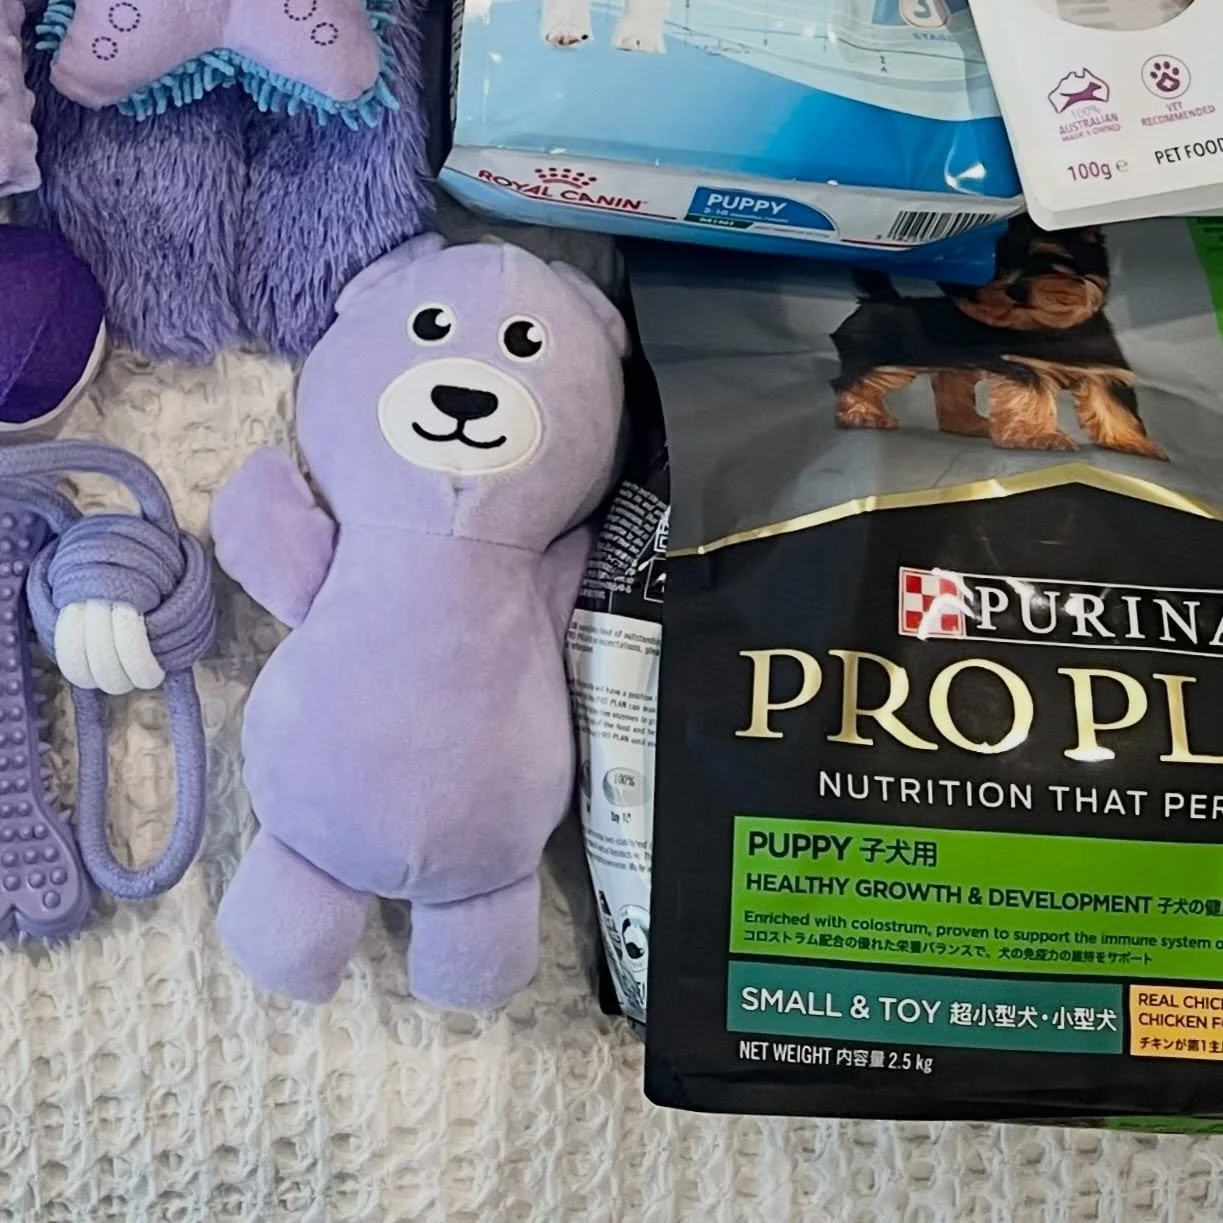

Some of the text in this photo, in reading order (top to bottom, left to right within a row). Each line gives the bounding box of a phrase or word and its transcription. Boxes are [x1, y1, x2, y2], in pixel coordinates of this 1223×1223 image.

[1059, 113, 1120, 136] AUSTRALIAN
[1140, 104, 1216, 127] RECOMMENDED
[1067, 160, 1112, 183] 100g
[1155, 146, 1181, 165] PET
[478, 169, 643, 212] ROYAL CANIN
[707, 193, 788, 216] PUPPY
[735, 648, 1034, 757] PRO
[818, 771, 1148, 817] NUTRITION THAT
[747, 830, 938, 868] PUPPY 子犬用
[746, 872, 1152, 915] HEALTHY GROWTH & DEVELOPMENT
[744, 910, 1211, 952] Enriched with colostrum, proven to support the immune system
[741, 985, 1117, 1032] SMALL & TOY 超小型犬・小型犬
[1138, 992, 1179, 1009] REAL
[1138, 1012, 1208, 1030] CHICKEN
[739, 1040, 769, 1061] NET
[772, 1042, 833, 1066] WEIGHT
[888, 1051, 912, 1071] 2.5
[915, 1053, 934, 1074] kg
